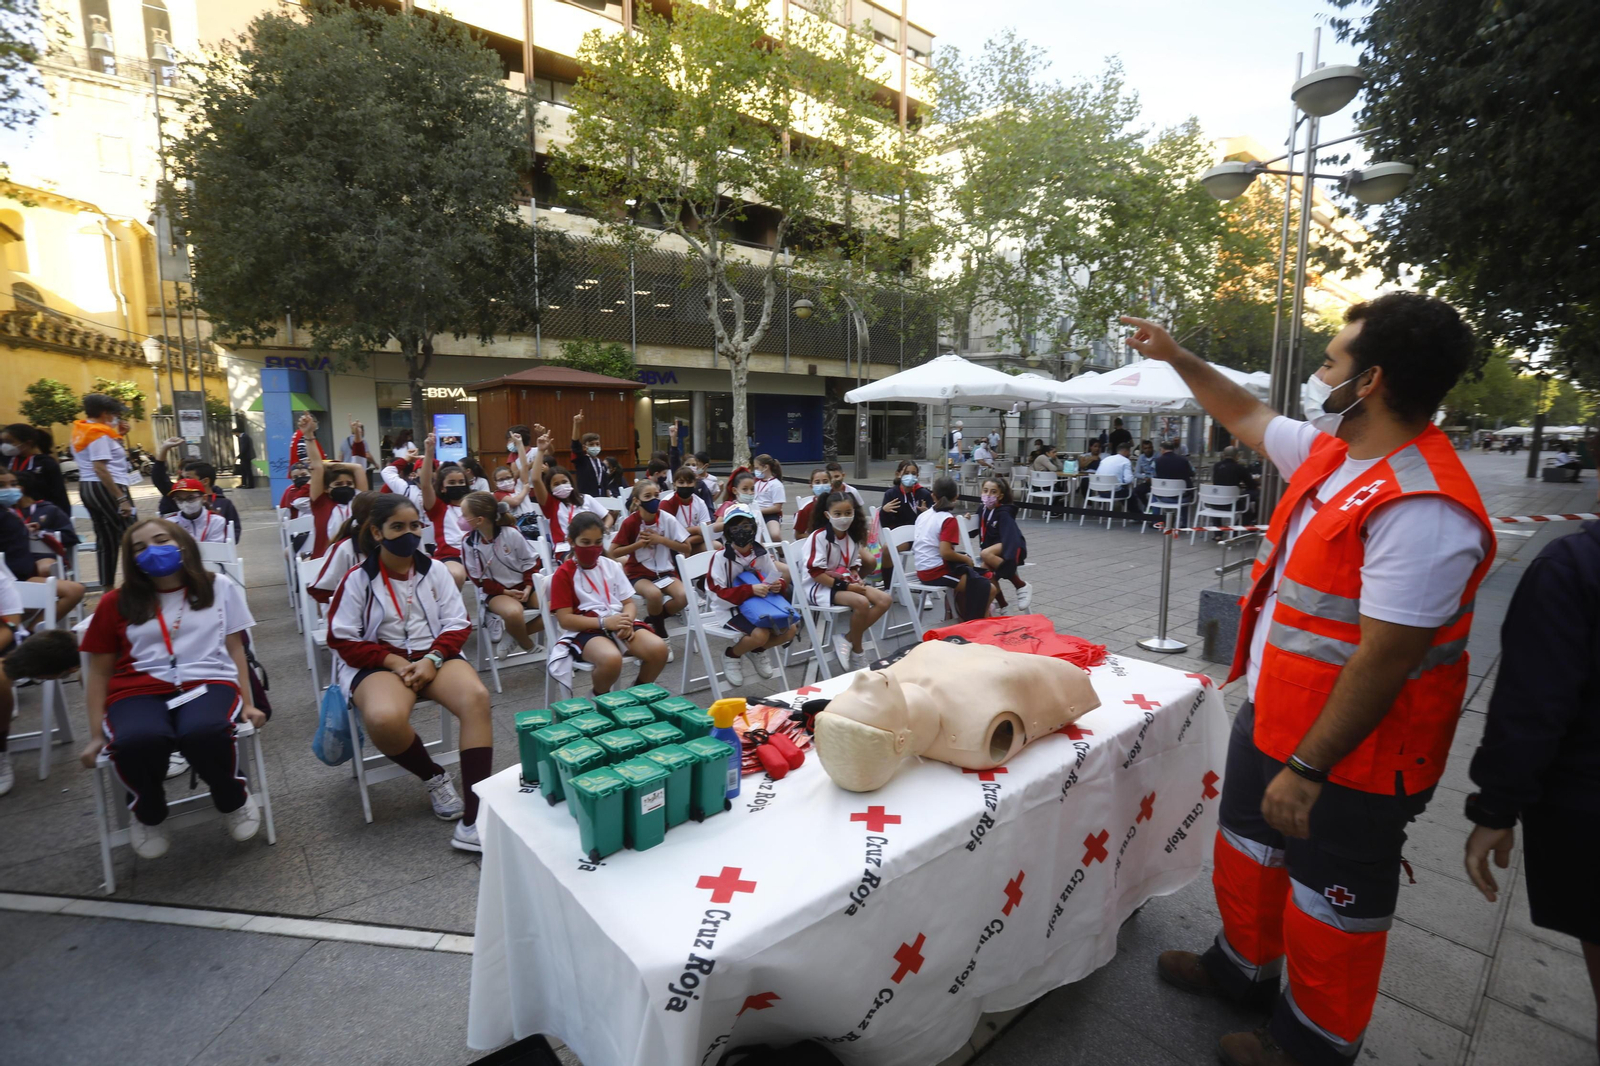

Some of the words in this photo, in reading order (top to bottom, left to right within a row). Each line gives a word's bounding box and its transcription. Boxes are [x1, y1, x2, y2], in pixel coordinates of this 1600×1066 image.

[265, 356, 330, 370] BBVA
[637, 370, 679, 385] BBVA
[427, 387, 467, 398] BBVA
[1190, 690, 1205, 717] Cruz
[1138, 712, 1155, 741] Cruz
[1072, 742, 1090, 770] Cruz
[746, 791, 777, 813] Roja
[981, 783, 1002, 812] Cruz
[965, 811, 995, 852] Roja
[1182, 803, 1204, 830] Cruz
[864, 836, 889, 868] Cruz
[1119, 825, 1137, 857] Cruz
[1164, 827, 1187, 853] Roja
[844, 868, 882, 916] Roja
[1060, 868, 1085, 903] Cruz
[693, 909, 732, 950] Cruz
[1046, 902, 1064, 939] Roja
[664, 953, 716, 1012] Roja
[948, 957, 977, 994] Roja
[858, 988, 894, 1031] Cruz
